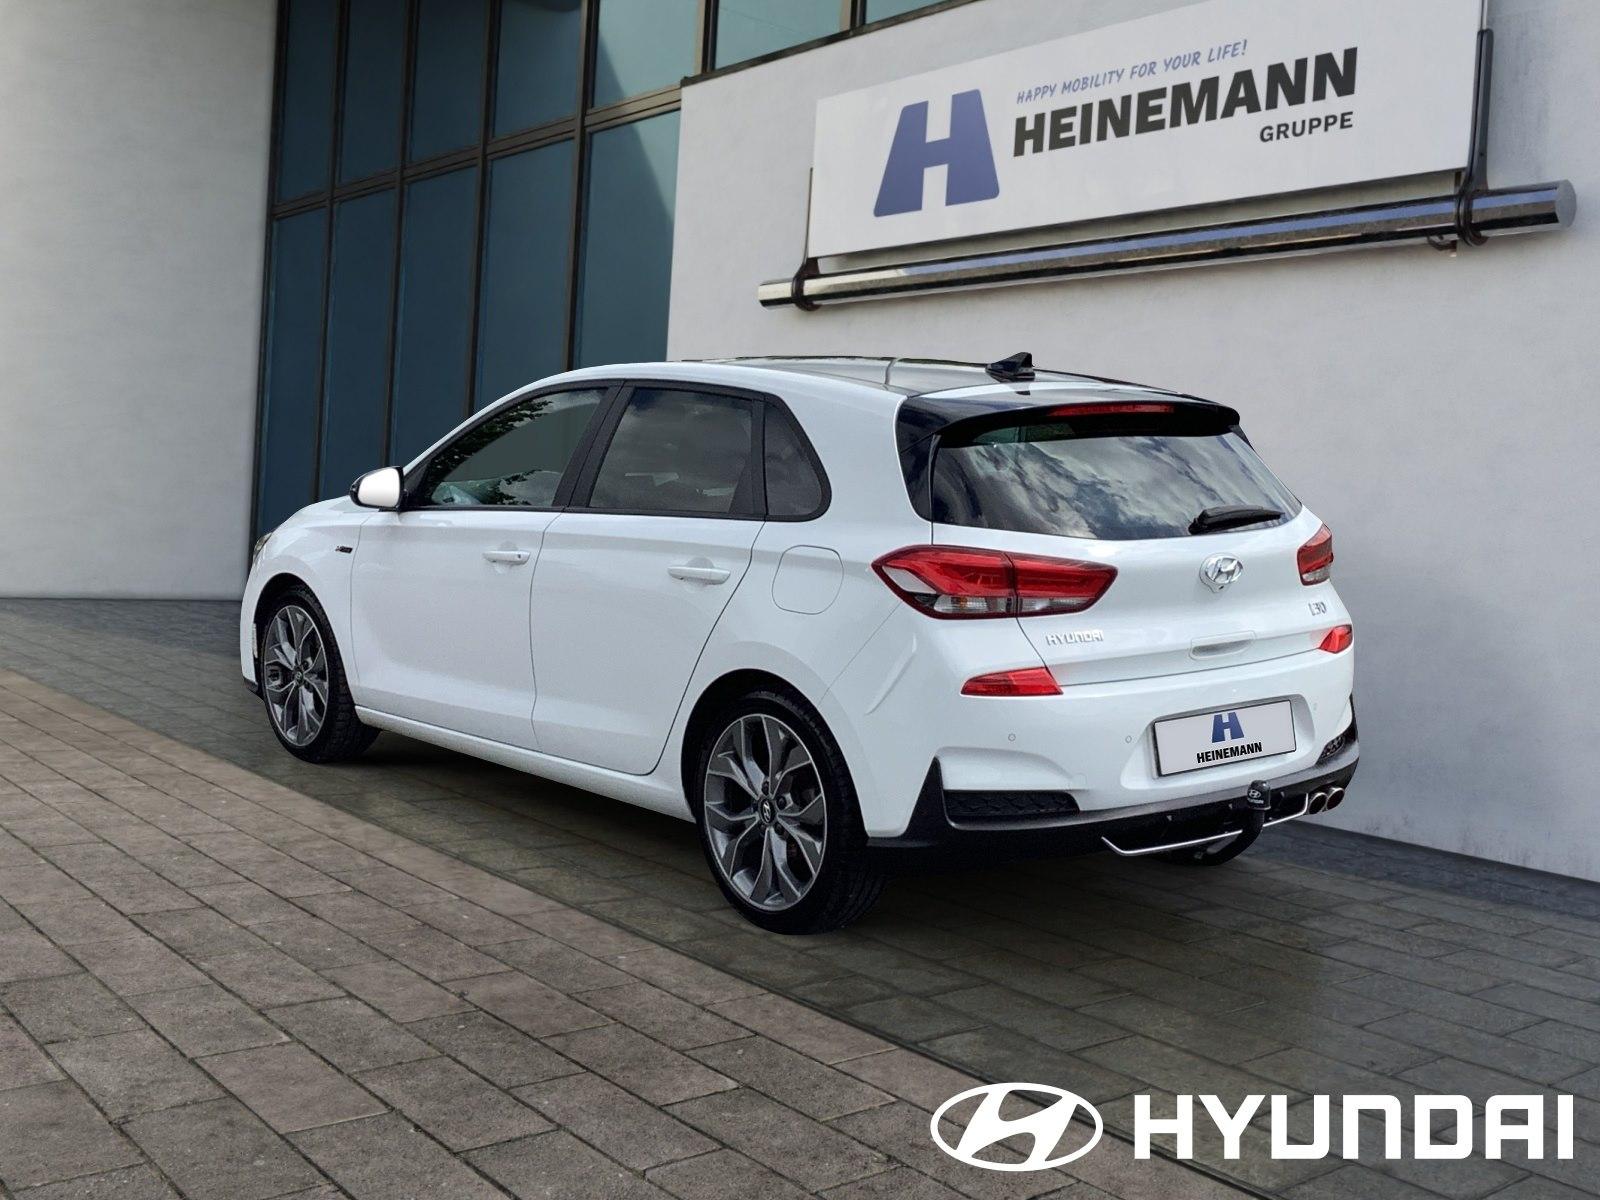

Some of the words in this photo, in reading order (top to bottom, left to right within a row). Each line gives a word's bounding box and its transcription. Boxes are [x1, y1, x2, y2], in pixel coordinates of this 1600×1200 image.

[1016, 83, 1058, 105] HAPPY
[1060, 66, 1126, 94] MOBILITY
[1129, 60, 1158, 81] FOR
[1162, 51, 1202, 74] YOUR
[1206, 39, 1249, 66] LIFE!
[1013, 47, 1358, 157] HEINEMANN
[1258, 111, 1354, 144] GRUPPE
[1045, 629, 1105, 646] HYUNDAI
[1196, 741, 1263, 764] HEINEMANN
